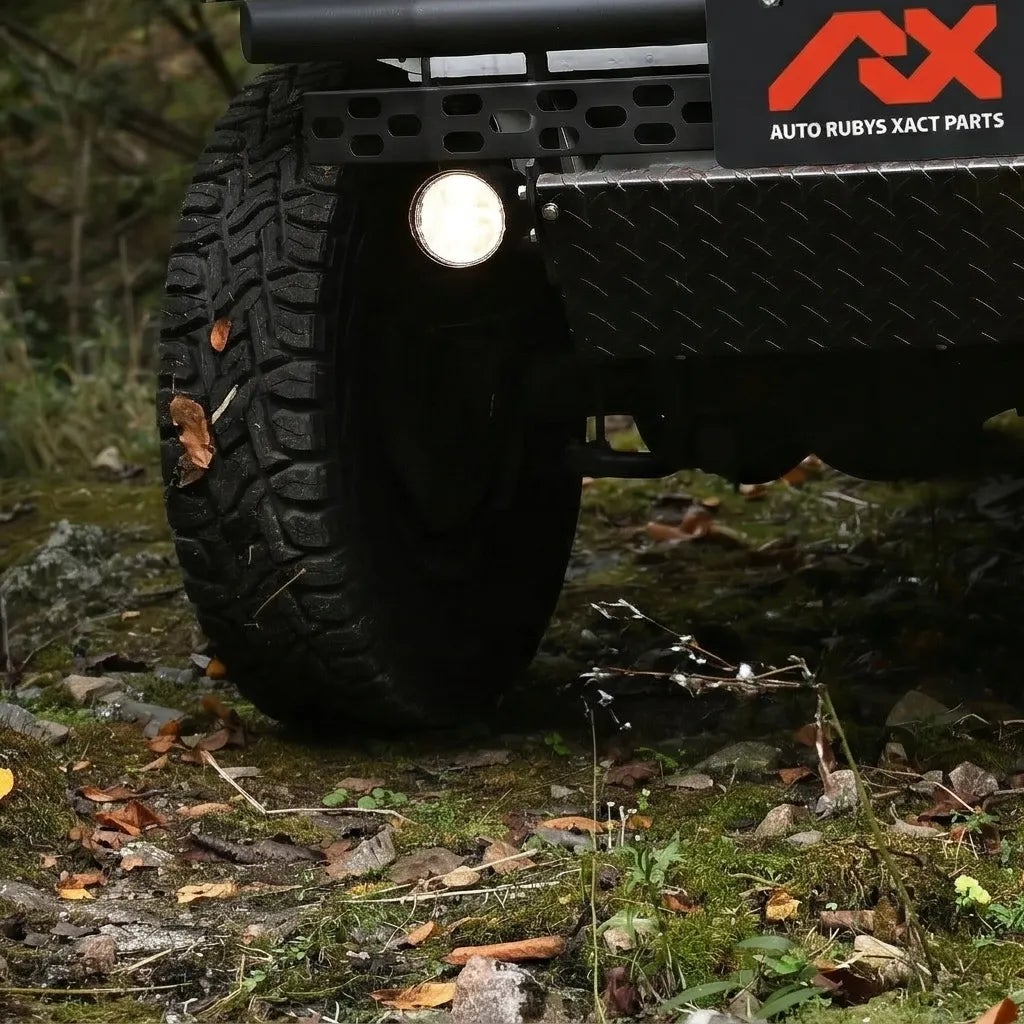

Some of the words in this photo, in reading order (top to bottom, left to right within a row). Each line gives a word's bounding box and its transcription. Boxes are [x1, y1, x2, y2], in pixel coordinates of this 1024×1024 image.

[769, 122, 822, 141] AUTO
[825, 118, 888, 138] RUBYS
[890, 116, 941, 134] XACT
[944, 112, 1005, 131] PARTS
